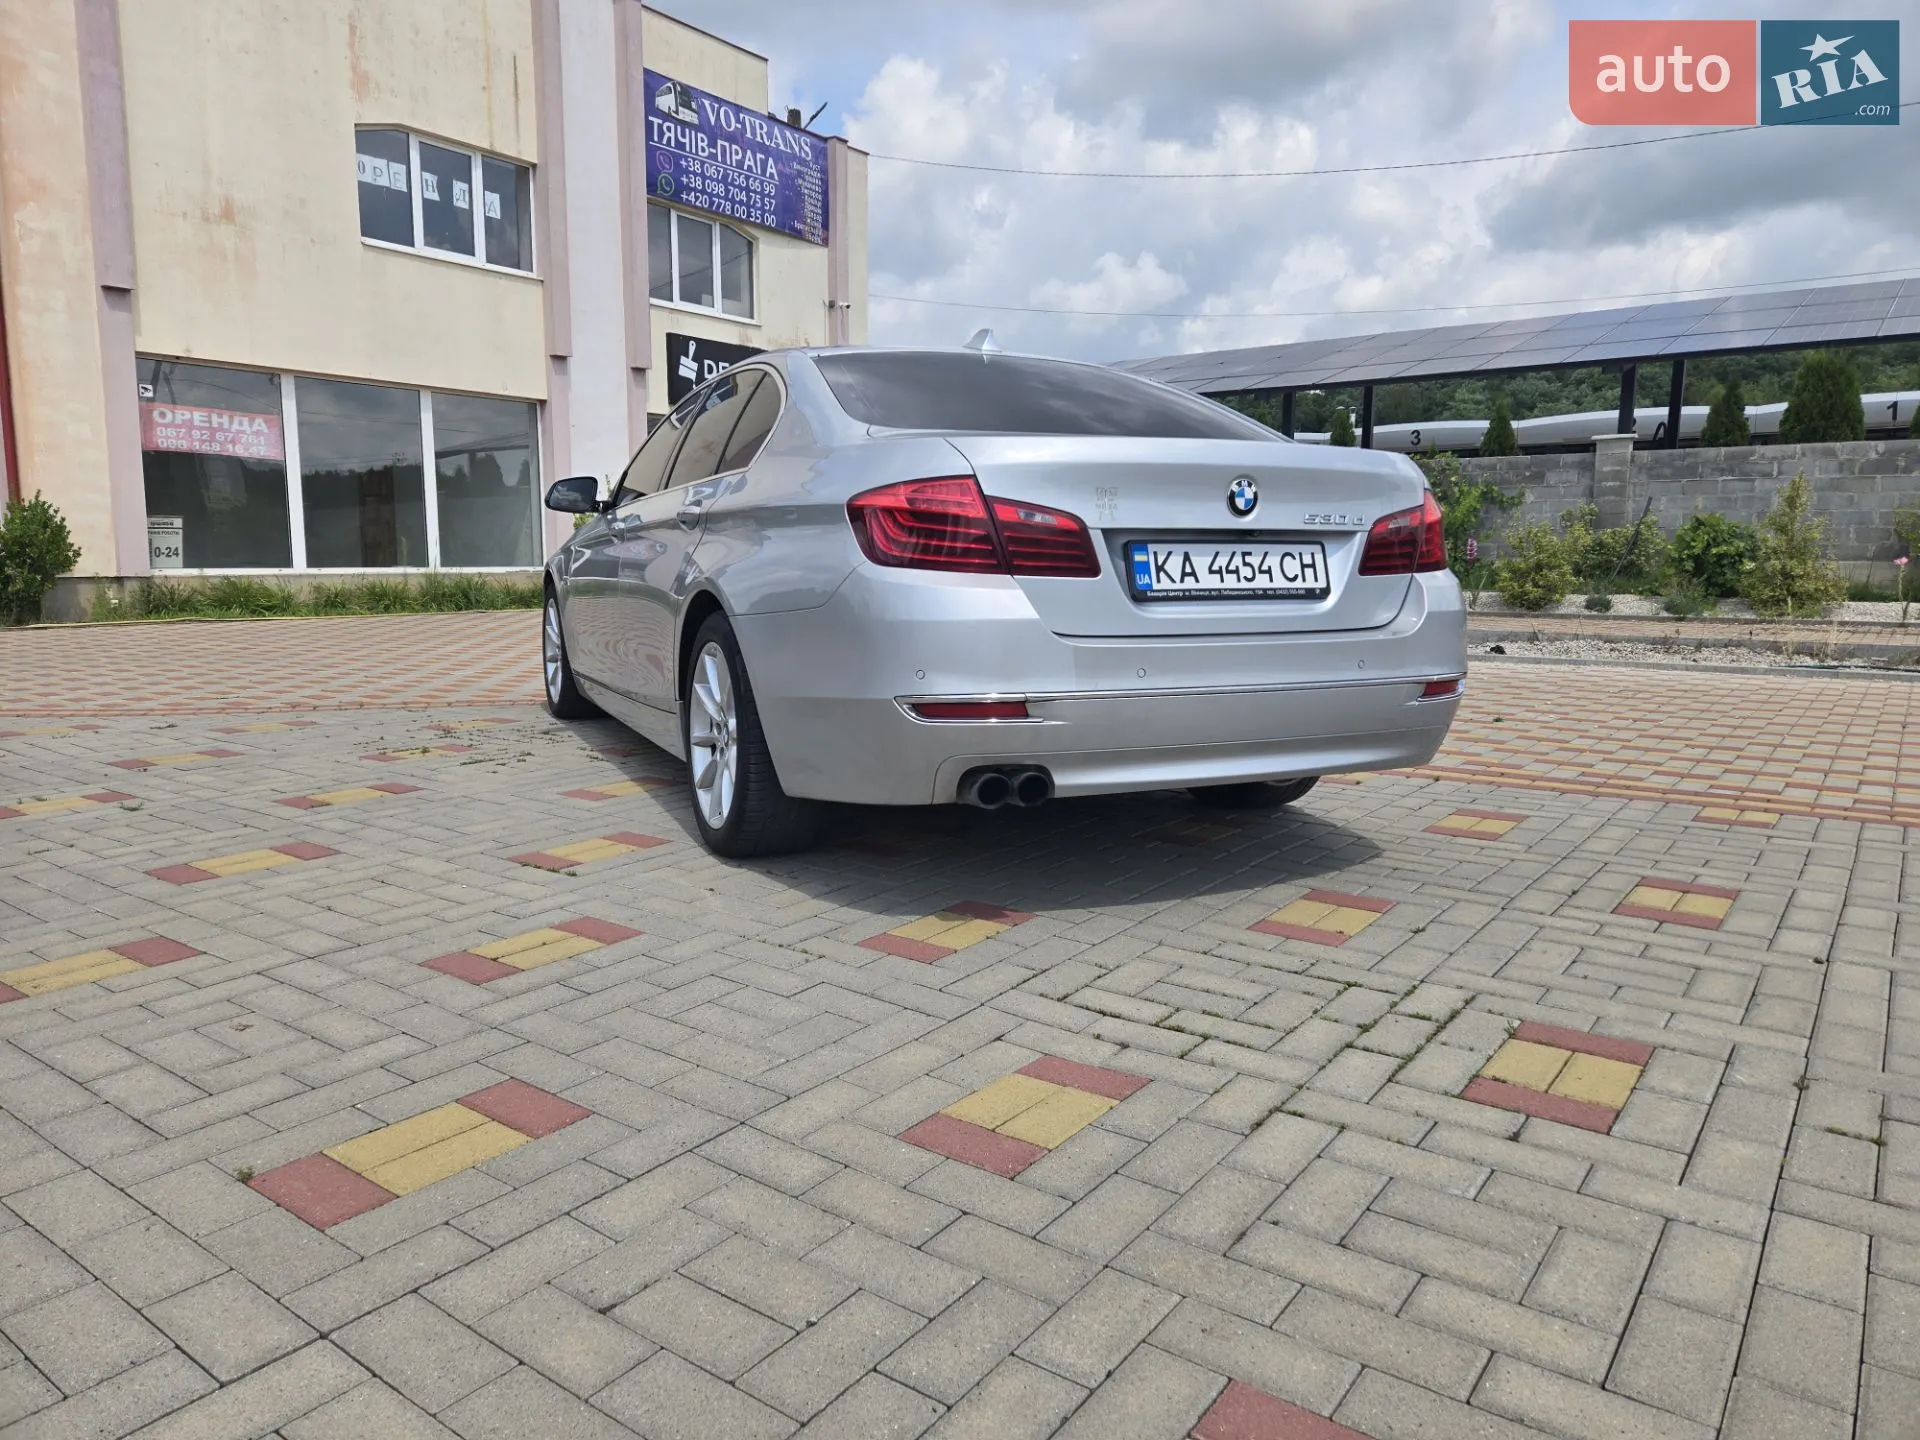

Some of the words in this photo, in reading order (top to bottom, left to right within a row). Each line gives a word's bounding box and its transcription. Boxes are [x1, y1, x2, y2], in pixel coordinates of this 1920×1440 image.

[700, 98, 812, 161] VO-TRANS
[649, 116, 779, 181] ТЯЧІВ-ПРАГА
[680, 157, 701, 173] +38
[704, 163, 724, 180] 067
[727, 170, 746, 187] 756
[749, 177, 761, 192] 66
[764, 181, 776, 196] 99
[680, 174, 702, 189] +38
[705, 179, 725, 197] 098
[727, 186, 747, 203] 704
[750, 192, 761, 207] 75
[764, 197, 776, 212] 57
[680, 190, 709, 208] +420
[712, 198, 731, 217] 778
[734, 204, 747, 219] 00
[750, 209, 761, 223] 35
[764, 213, 776, 227] 00
[152, 407, 269, 434] ОРЕНДА
[156, 426, 186, 437] 067
[191, 429, 210, 440] 92
[215, 431, 234, 442] 67
[1410, 429, 1421, 446] 3
[1137, 574, 1150, 585] UA
[1153, 551, 1200, 584] KA
[1208, 551, 1274, 583] 4454
[1279, 552, 1319, 583] CH
